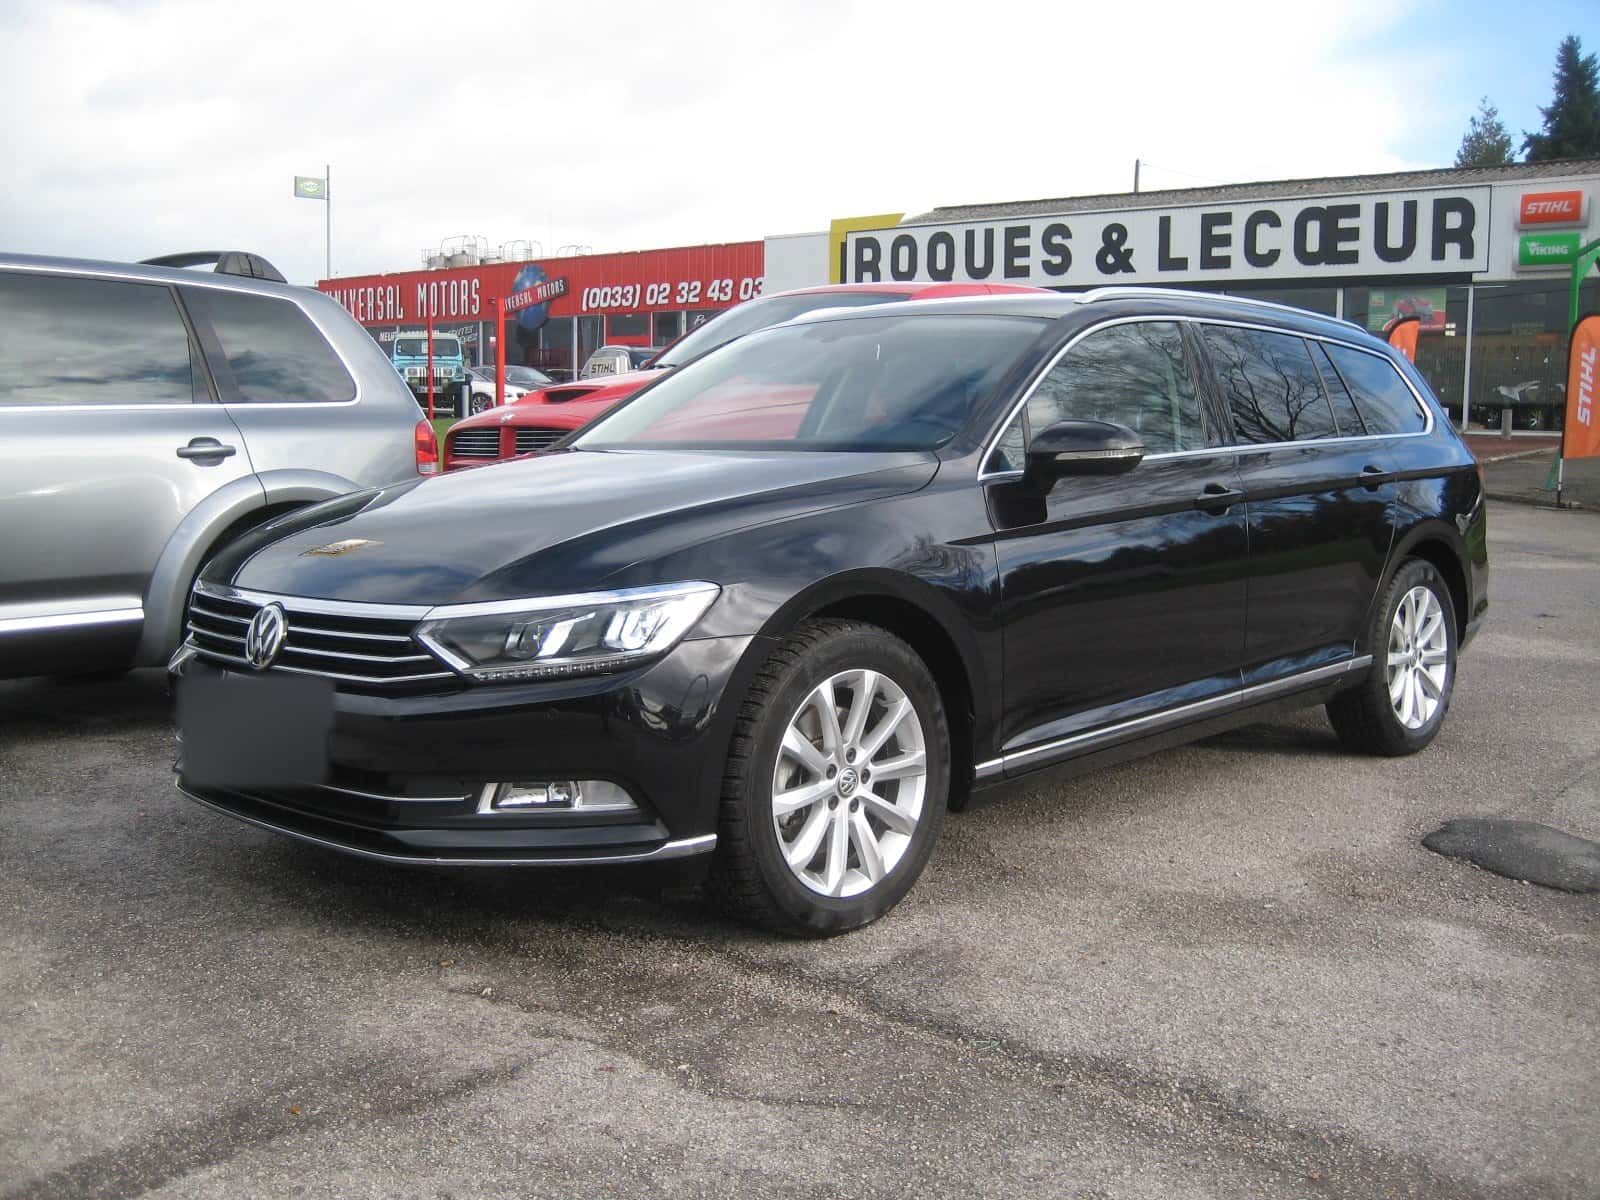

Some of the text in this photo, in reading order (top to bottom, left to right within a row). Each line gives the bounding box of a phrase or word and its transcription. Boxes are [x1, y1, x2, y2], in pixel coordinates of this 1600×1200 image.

[1525, 200, 1573, 215] STIHL
[855, 197, 1475, 283] ROQUES & LECŒUR
[1527, 243, 1569, 256] VIKING
[417, 278, 480, 318] MOTORS
[537, 279, 565, 300] MOTORS
[582, 277, 766, 311] (0033) 02 32 43 03
[591, 363, 615, 374] STIHL
[1577, 347, 1597, 427] STIHL
